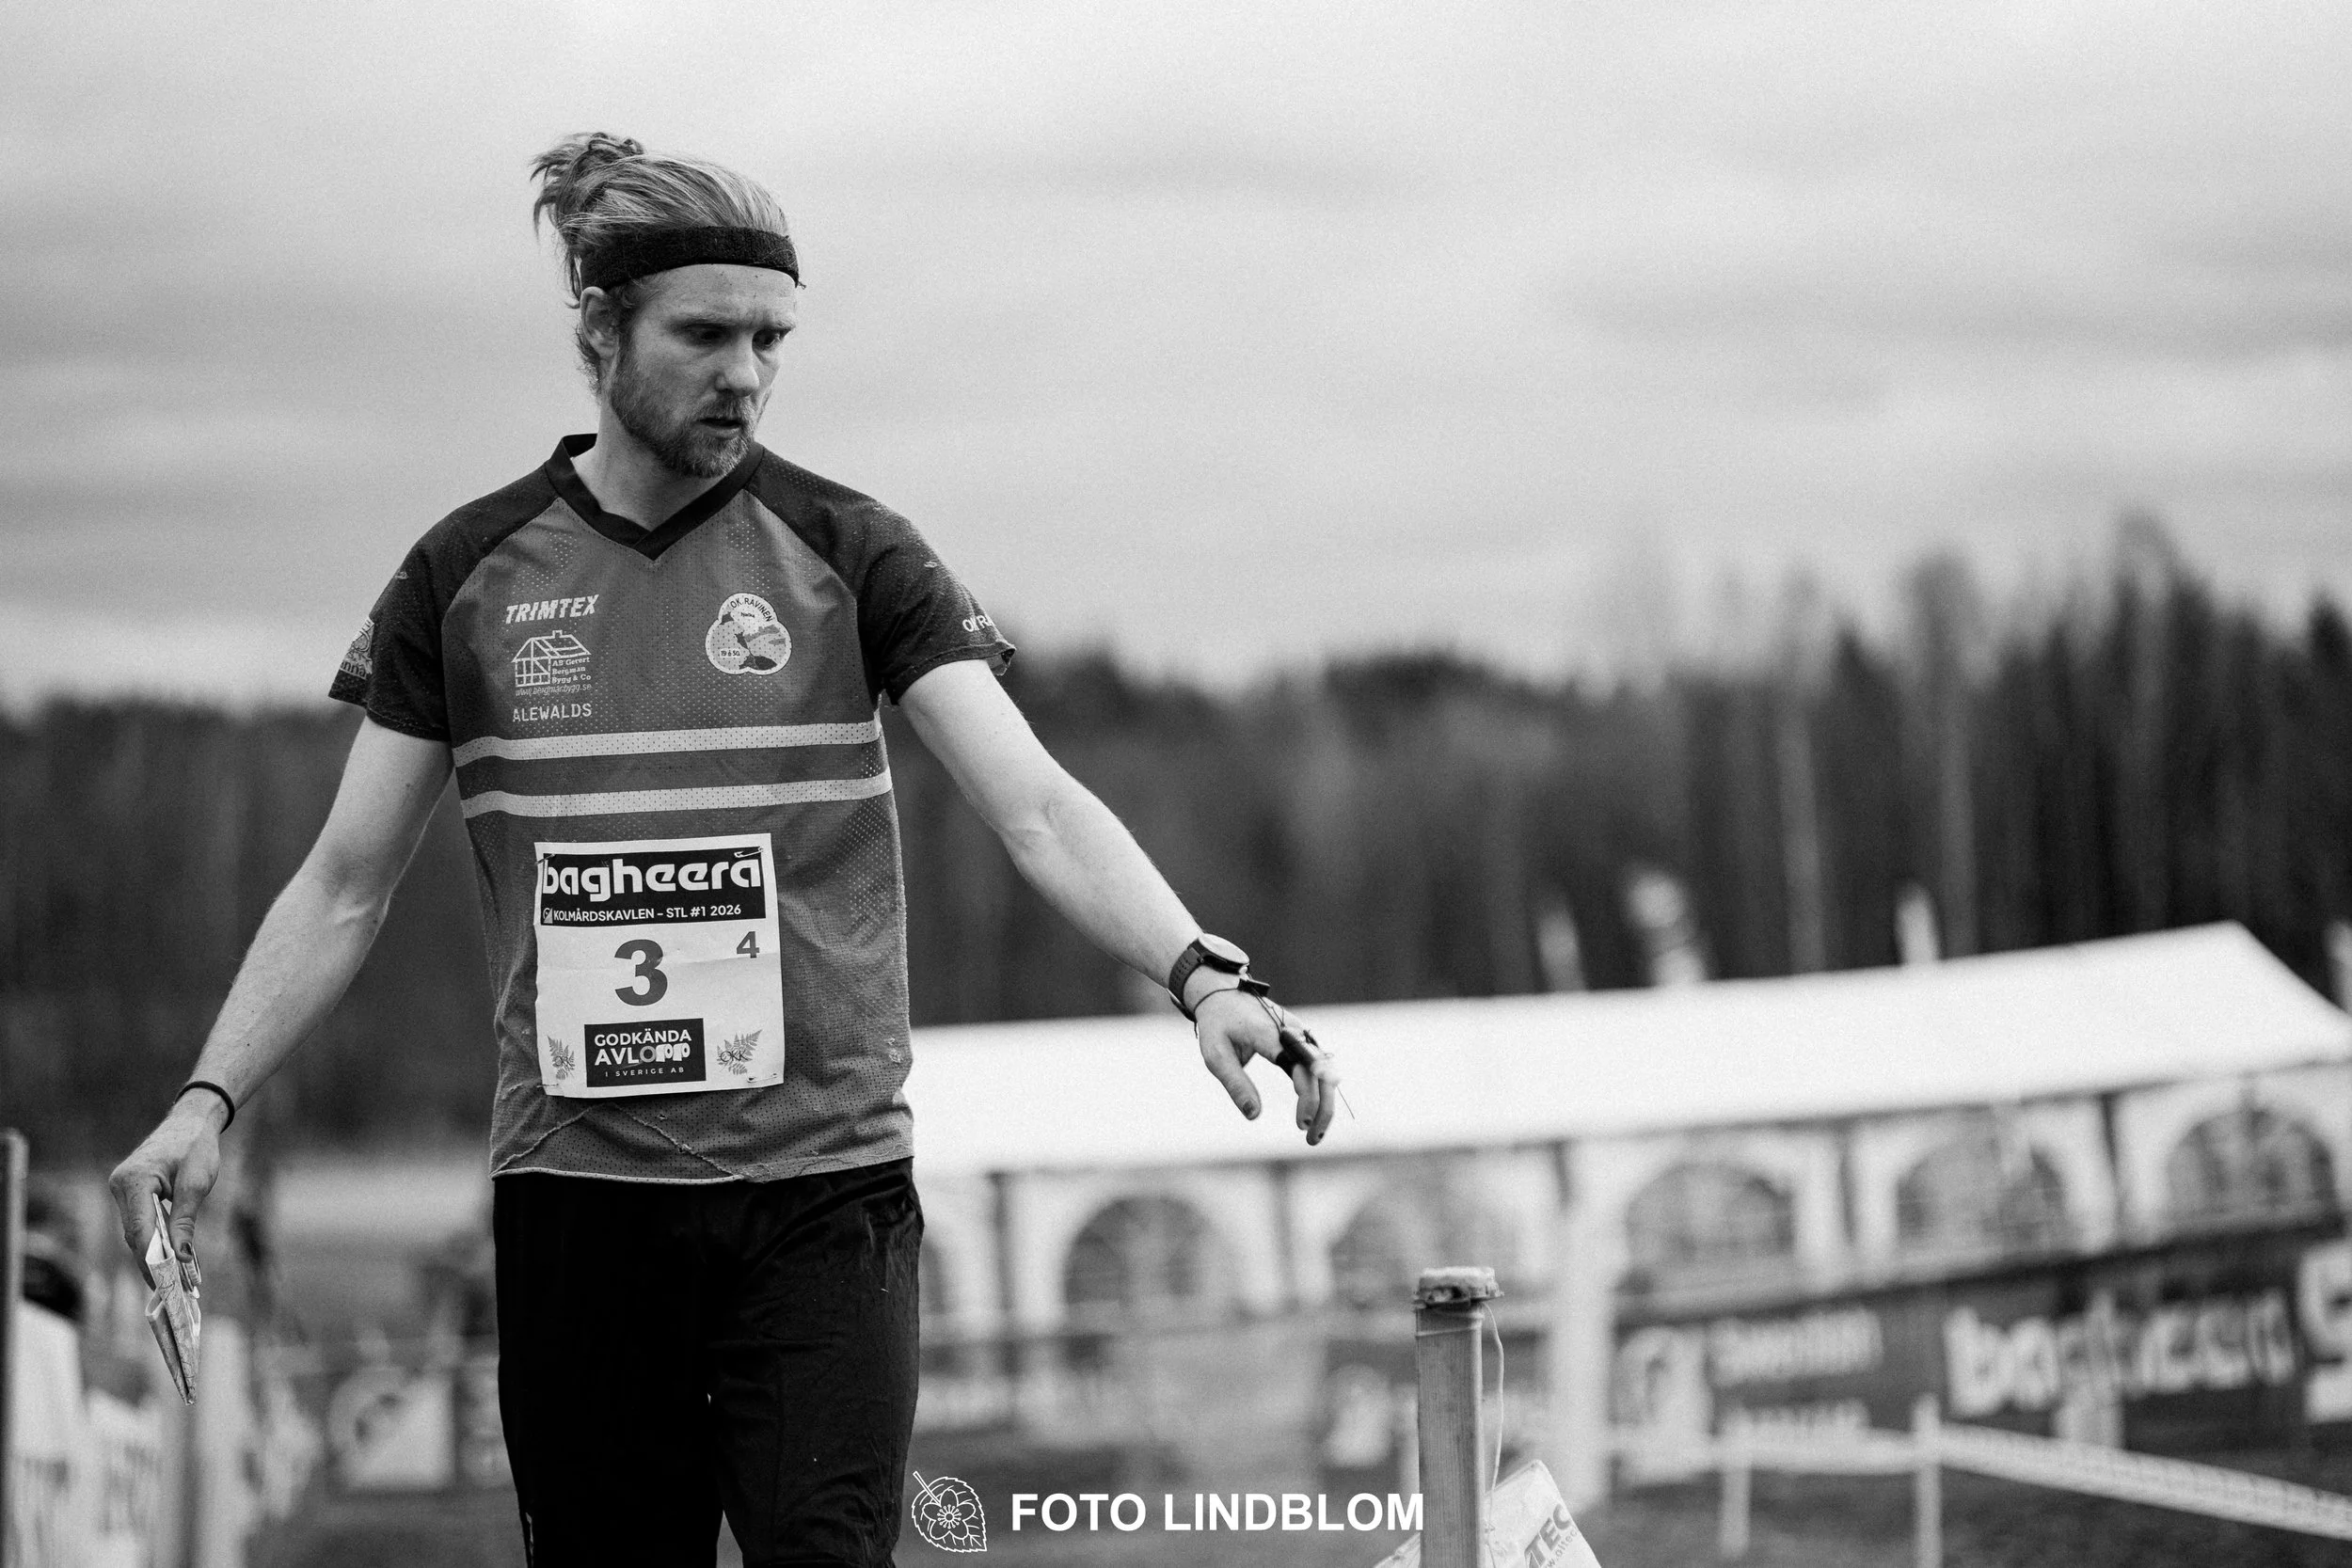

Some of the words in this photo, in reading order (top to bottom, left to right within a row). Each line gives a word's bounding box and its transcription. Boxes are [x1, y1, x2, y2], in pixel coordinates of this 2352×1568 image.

[506, 594, 599, 624] TRIMTEX
[730, 597, 742, 609] OK
[744, 597, 773, 622] RAVINEN
[513, 703, 592, 722] ALEWALDS
[542, 858, 762, 902] bagheera
[553, 907, 655, 922] KOLMÅRDSKAVLEN
[666, 907, 688, 918] STL
[691, 907, 706, 918] #1
[710, 904, 742, 917] 2026
[736, 930, 761, 959] 4
[613, 939, 669, 1007] 3
[594, 1028, 692, 1047] GODKÄNDA
[594, 1043, 691, 1066] AVLOPP
[615, 1069, 664, 1077] SVERIGE
